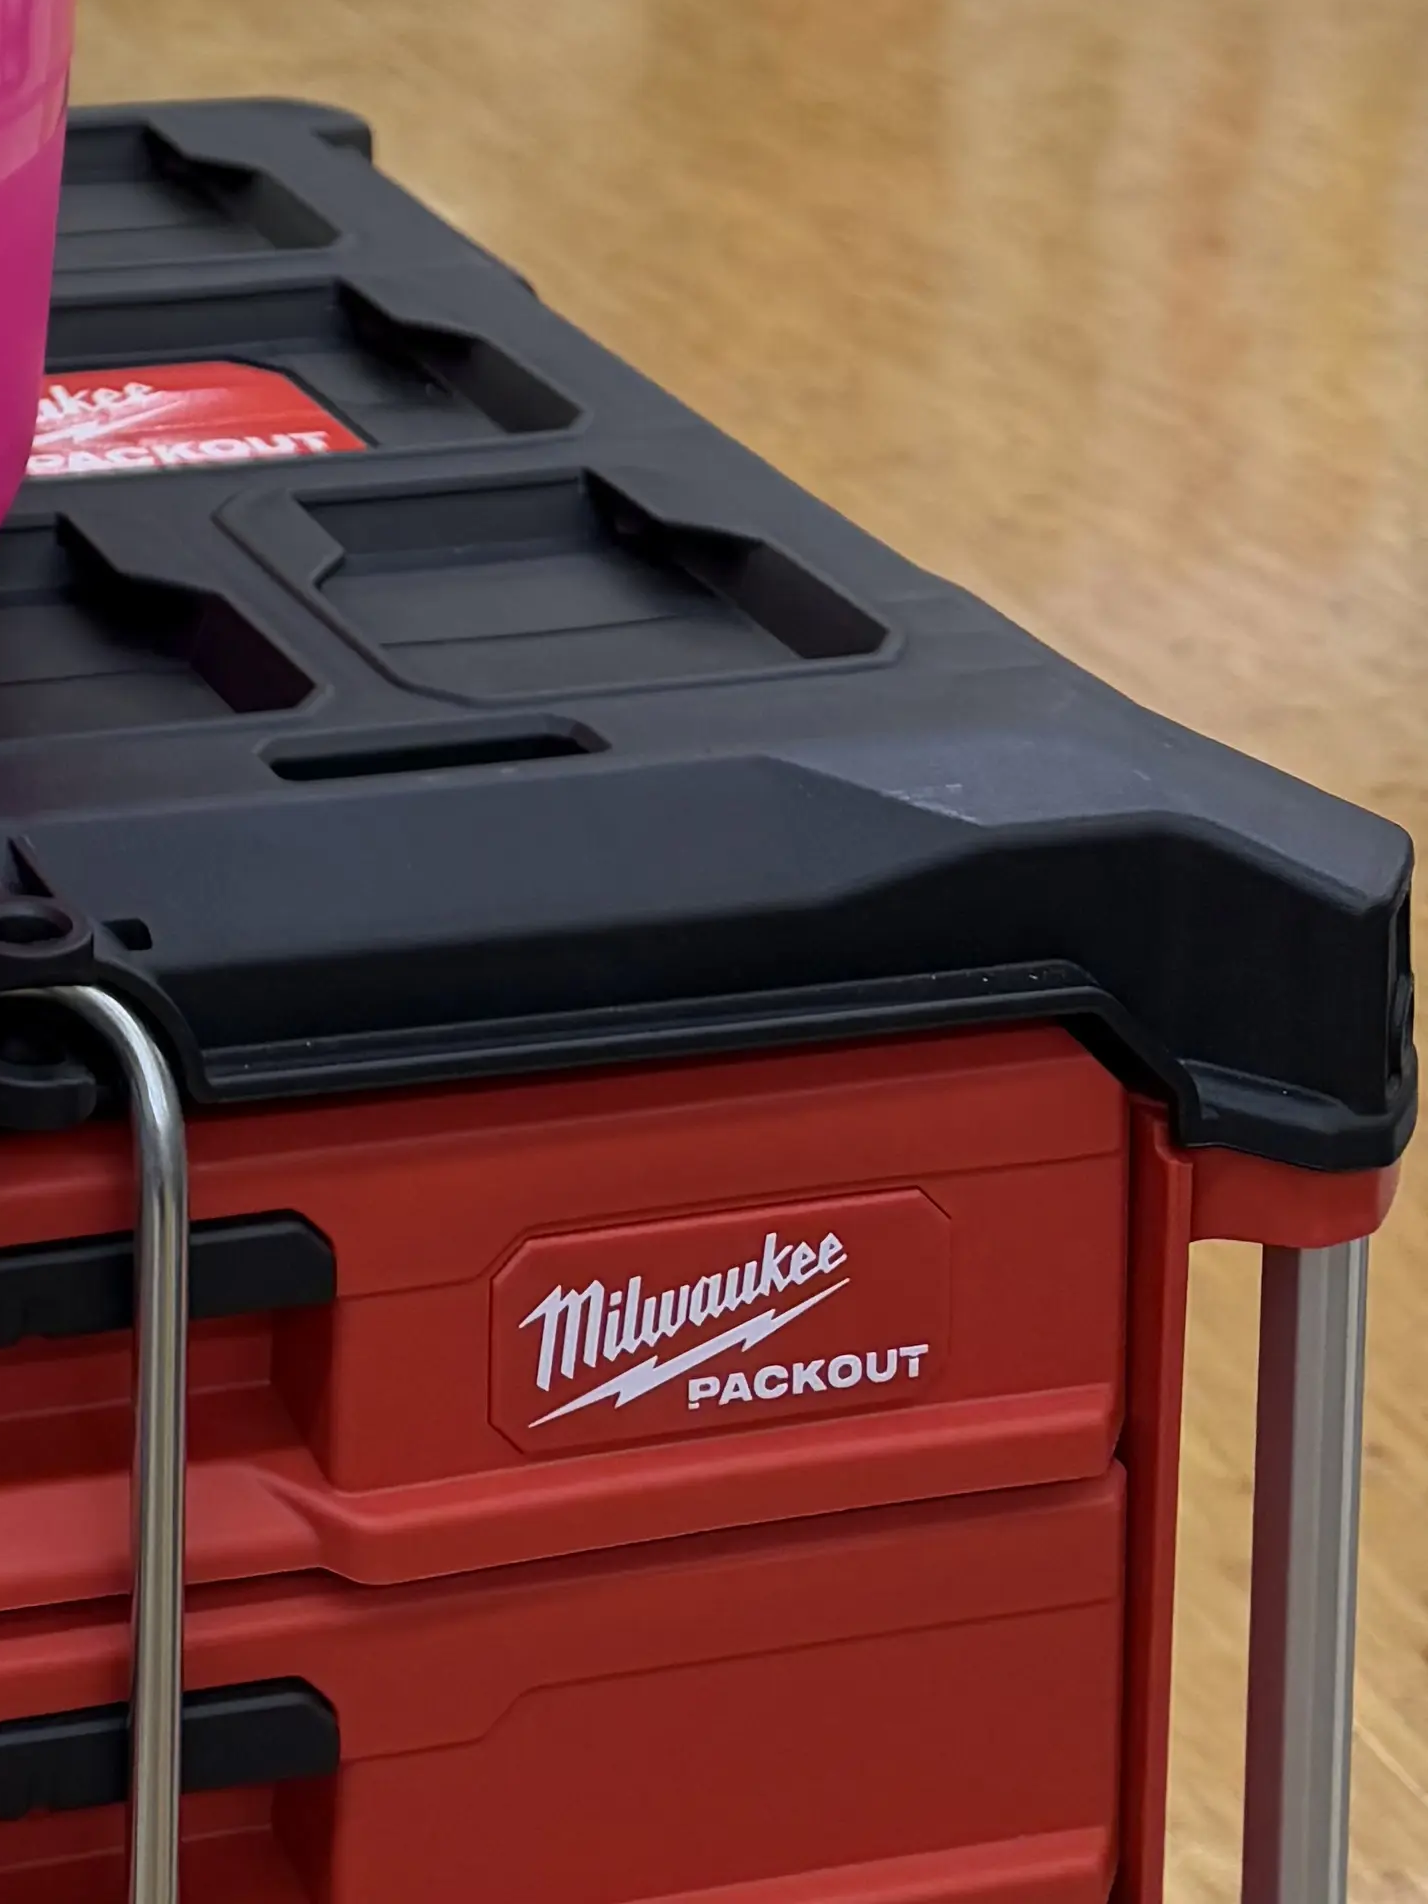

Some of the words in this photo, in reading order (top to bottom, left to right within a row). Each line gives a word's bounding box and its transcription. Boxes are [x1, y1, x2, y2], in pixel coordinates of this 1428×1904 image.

[27, 430, 331, 476] PACKOUT
[519, 1232, 848, 1391] Milwaukee
[687, 1343, 930, 1410] PACKOUT
